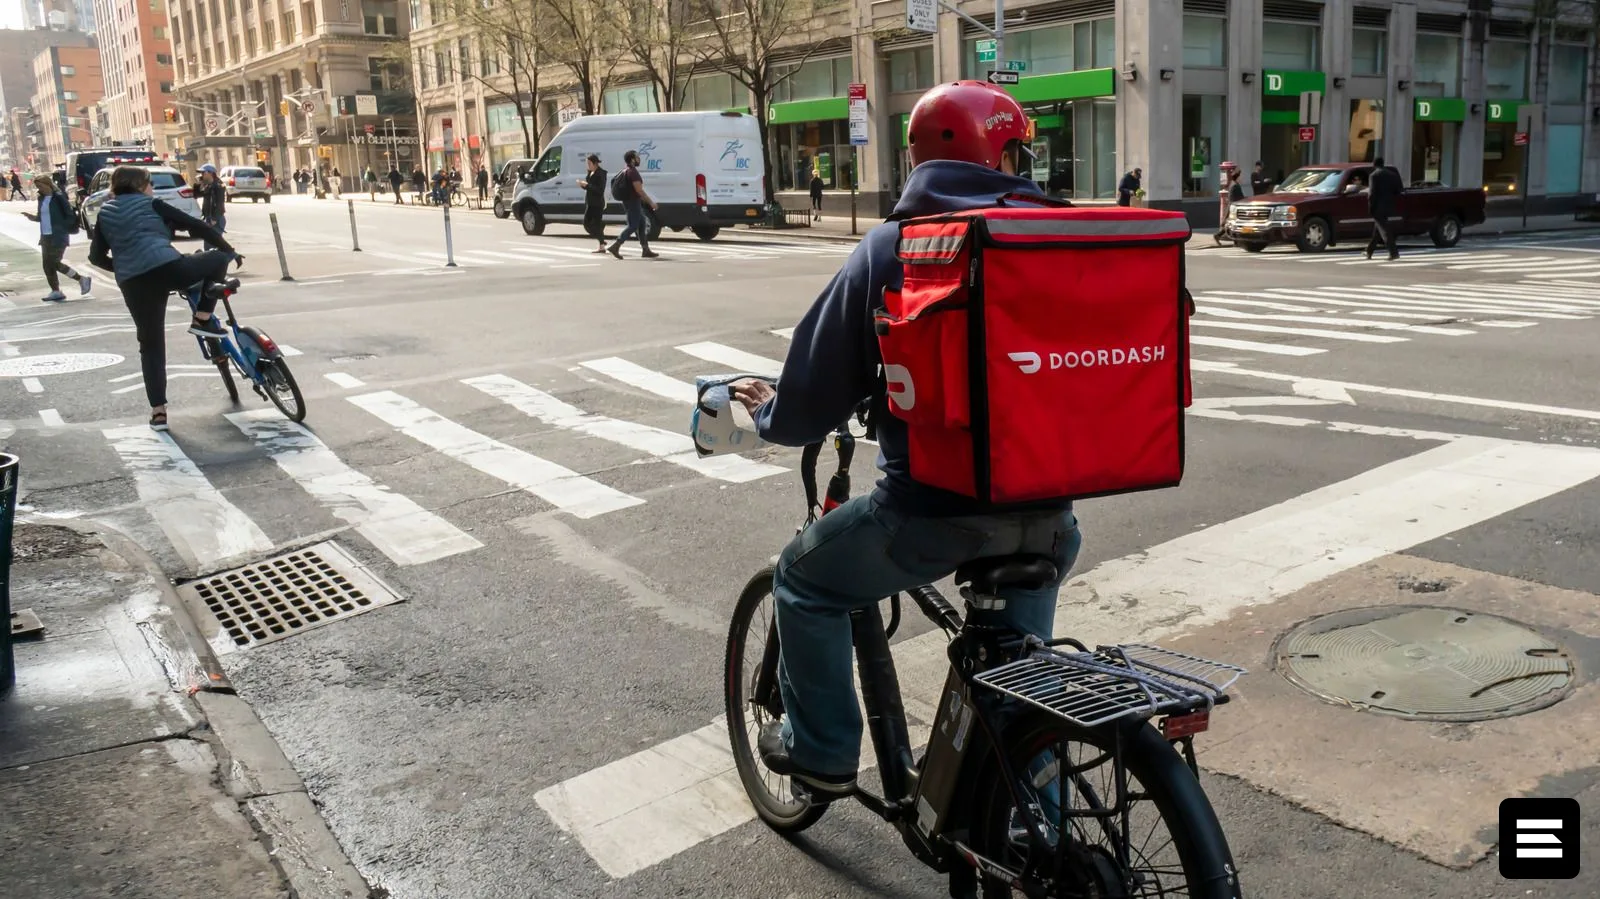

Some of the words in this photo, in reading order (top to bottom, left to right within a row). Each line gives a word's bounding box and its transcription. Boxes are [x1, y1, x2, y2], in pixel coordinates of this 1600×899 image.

[914, 9, 930, 18] ONLY
[1266, 74, 1282, 91] TD
[769, 107, 776, 121] D
[1418, 102, 1431, 117] TD
[1490, 104, 1502, 118] TD
[647, 159, 662, 170] IBC
[736, 157, 750, 169] IBC
[1049, 345, 1165, 370] DOORDASH
